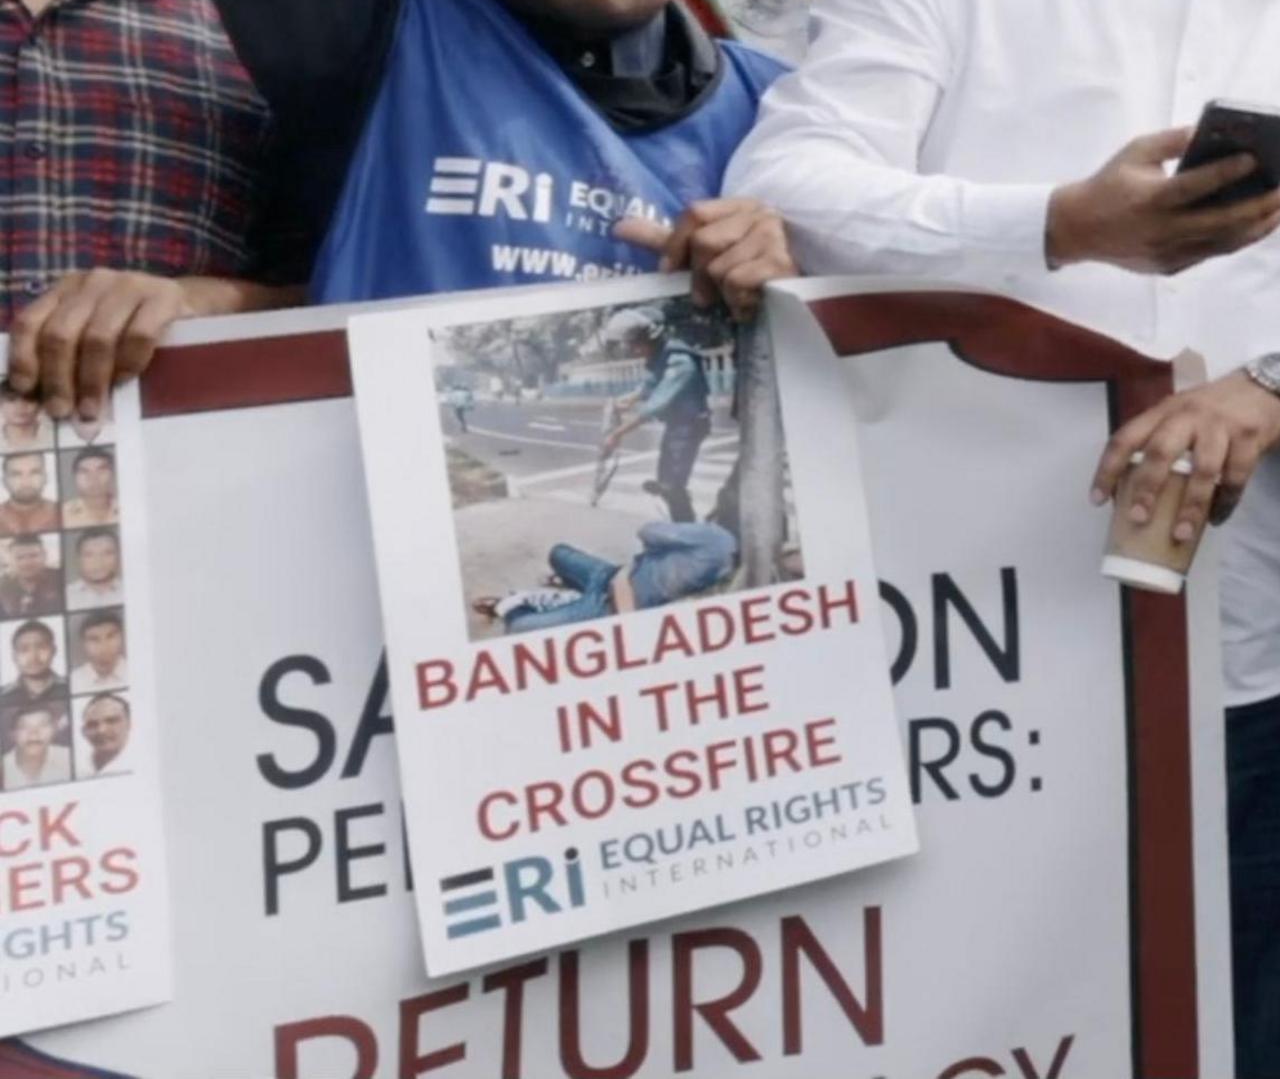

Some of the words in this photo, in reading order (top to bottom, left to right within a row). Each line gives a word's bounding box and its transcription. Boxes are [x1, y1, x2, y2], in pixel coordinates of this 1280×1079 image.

[414, 579, 860, 711] BANGLADESH
[556, 694, 622, 754] IN
[639, 664, 770, 733] THE
[476, 716, 843, 842] CROSSFIRE
[599, 812, 736, 870] EQUAL
[744, 776, 888, 835] RIGHTS
[601, 814, 893, 899] INTERNATIONAL
